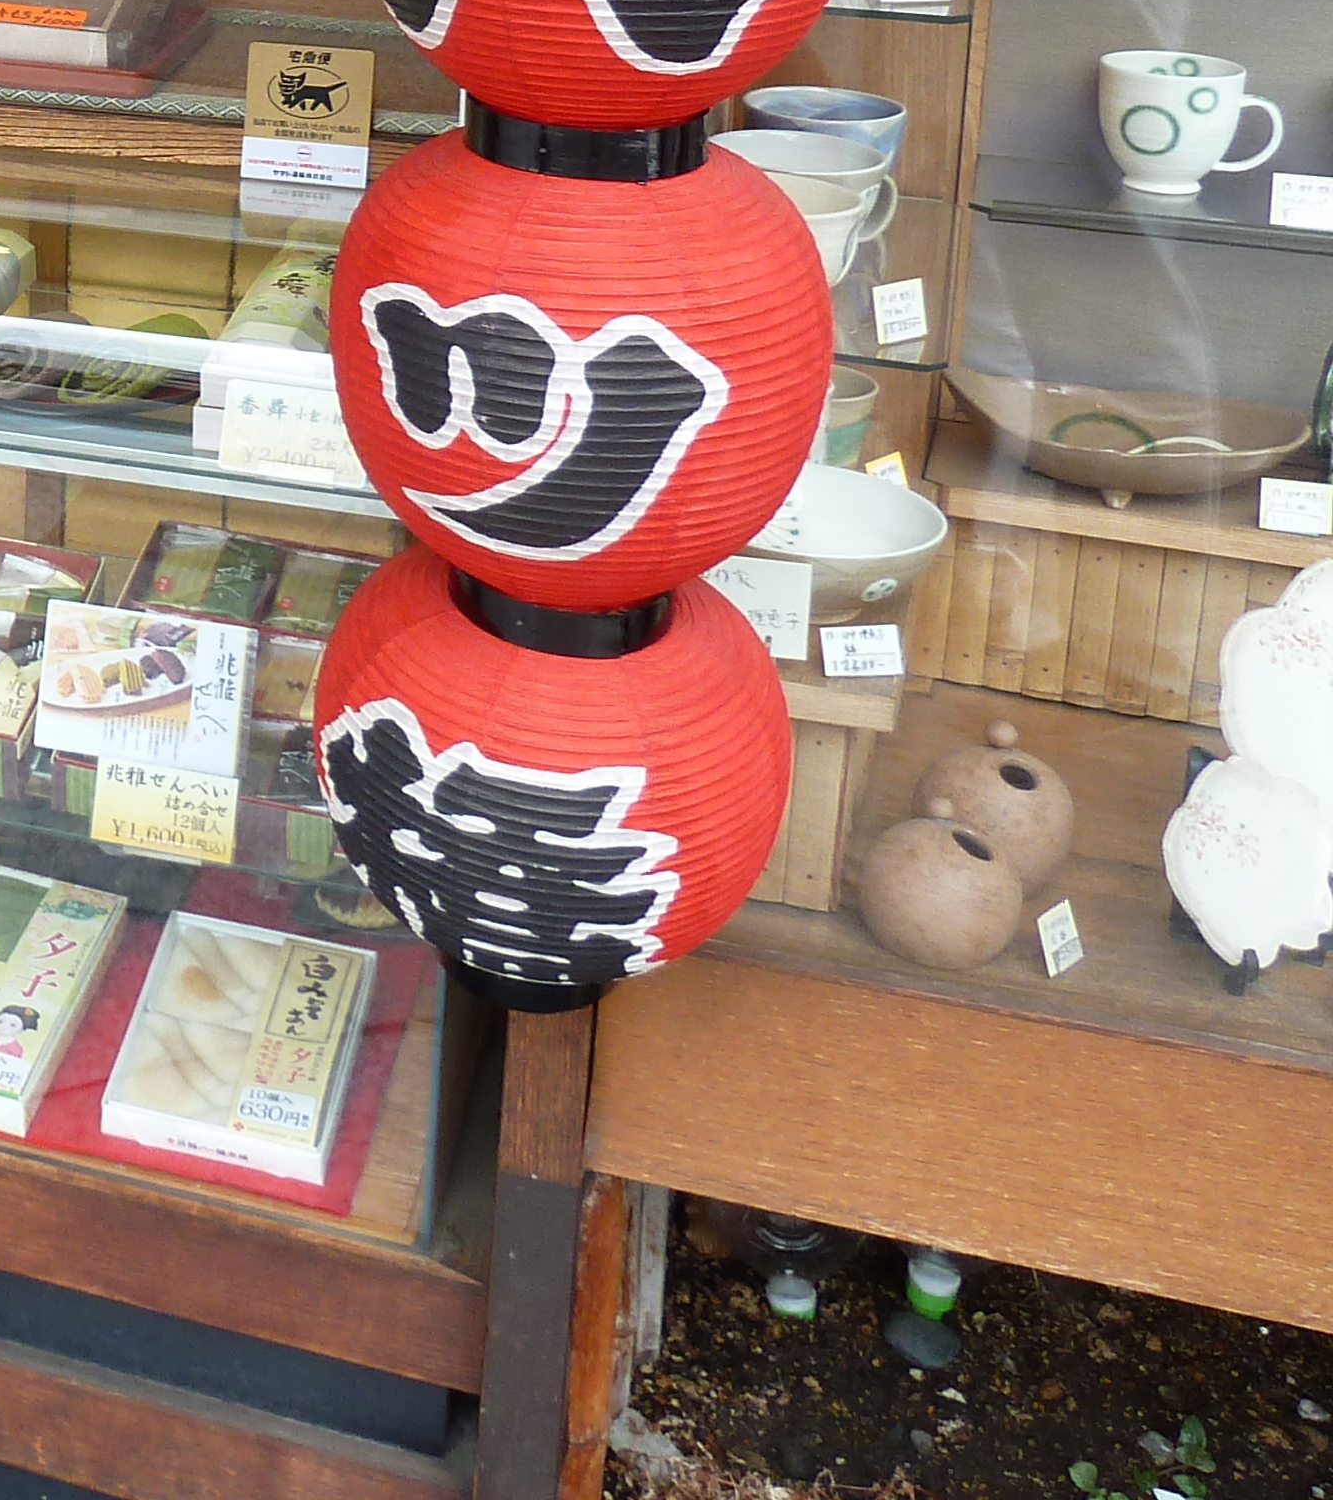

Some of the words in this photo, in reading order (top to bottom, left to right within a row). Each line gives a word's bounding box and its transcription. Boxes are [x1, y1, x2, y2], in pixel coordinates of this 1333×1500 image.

[288, 50, 332, 65] 宅急便
[105, 762, 230, 799] 兆雅せんべい
[164, 794, 229, 819] 詰め合せ
[110, 817, 185, 849] ¥1,600
[171, 812, 223, 836] 12個入
[15, 932, 78, 998] 夕子
[285, 1046, 312, 1084] 夕子
[239, 1102, 302, 1126] 630円
